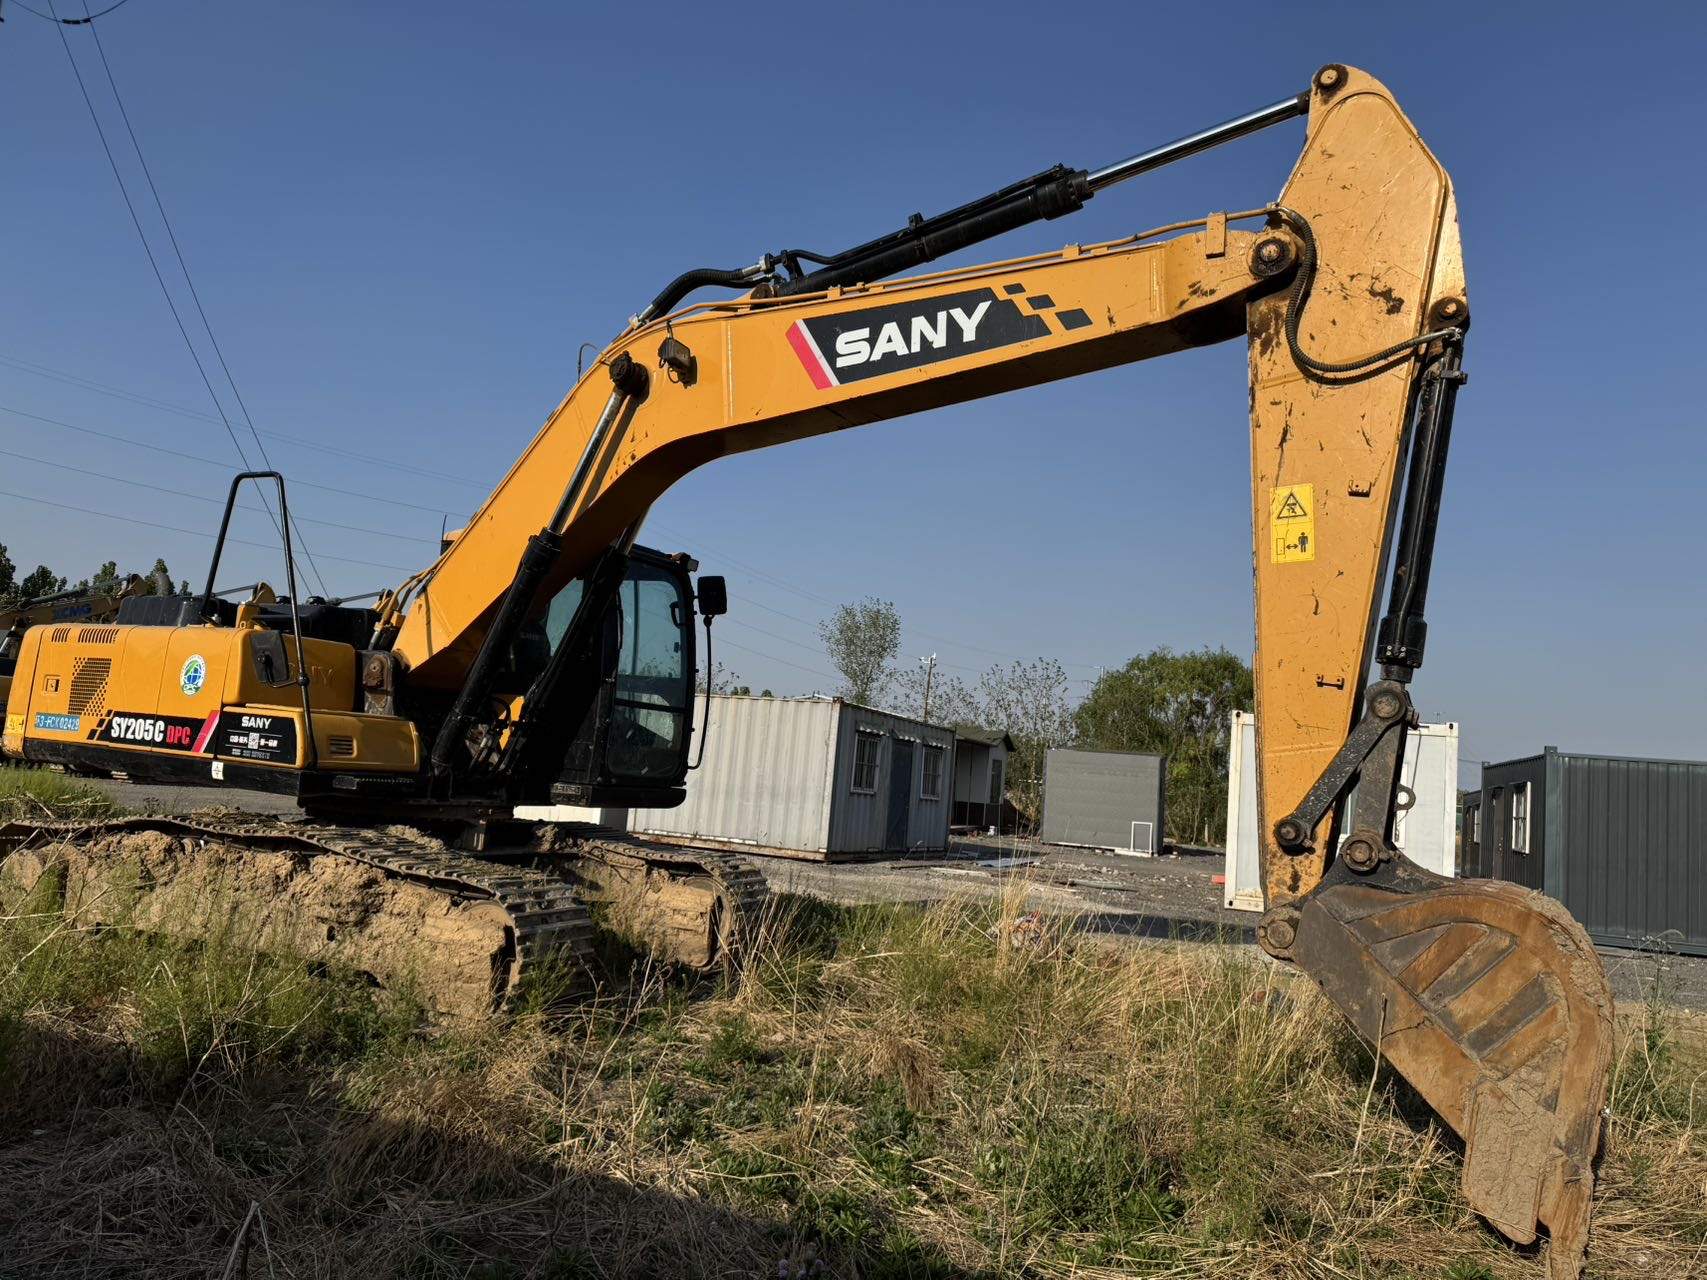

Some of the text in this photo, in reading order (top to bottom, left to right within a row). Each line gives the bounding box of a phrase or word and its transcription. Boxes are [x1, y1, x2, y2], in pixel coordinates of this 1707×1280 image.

[836, 300, 993, 369] SANY
[111, 716, 191, 744] SY205C DPC
[241, 716, 272, 729] SANY
